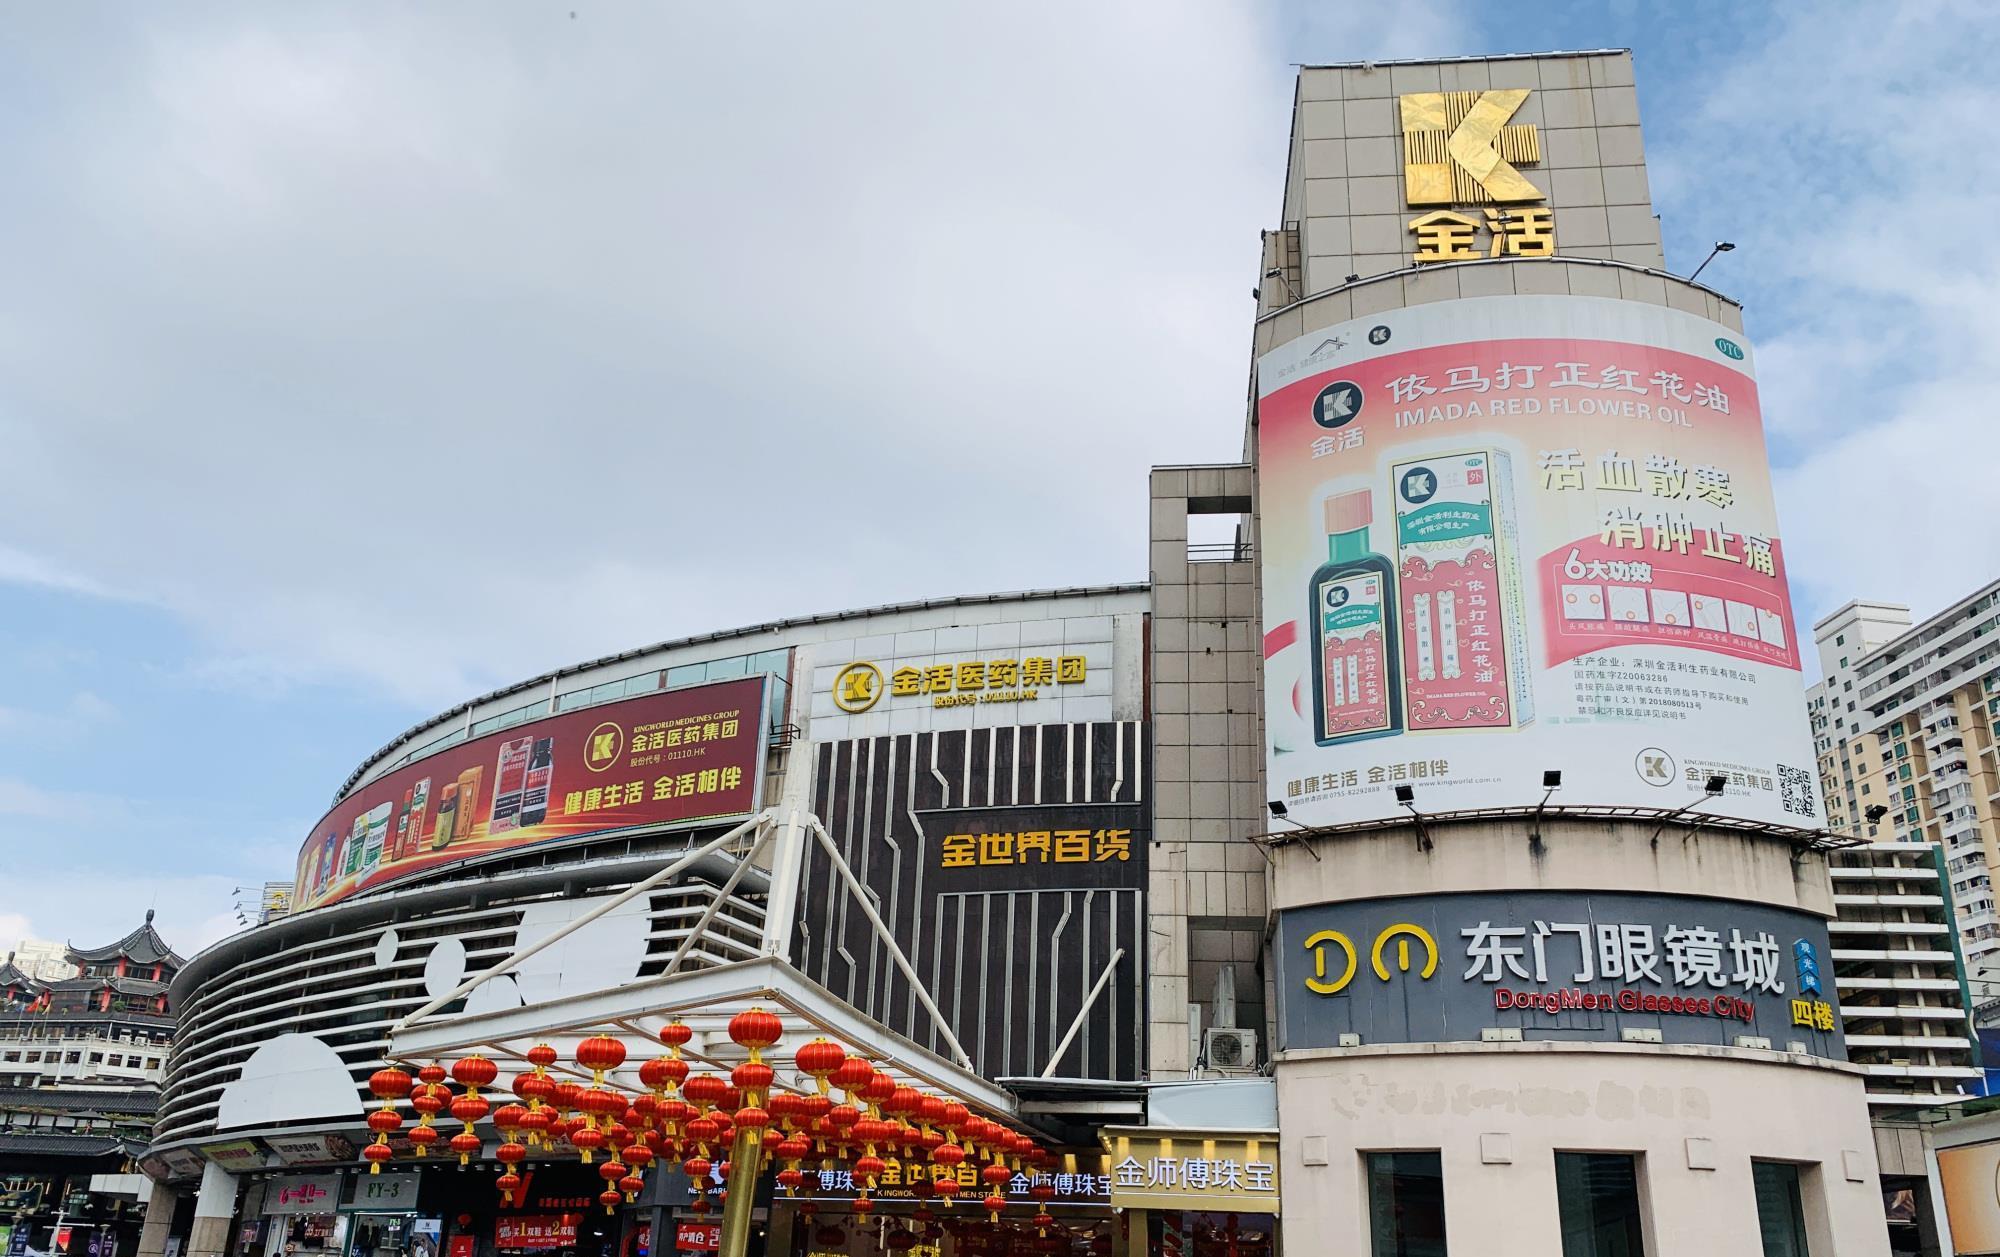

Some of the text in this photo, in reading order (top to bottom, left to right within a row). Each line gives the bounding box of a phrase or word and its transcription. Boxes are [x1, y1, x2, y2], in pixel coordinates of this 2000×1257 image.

[1408, 208, 1554, 262] 金活
[1718, 339, 1742, 359] OTC
[1385, 362, 1731, 416] 依马打正红花油
[1395, 398, 1694, 428] IMADA RED FLOWER OIL
[1311, 427, 1364, 460] 金活
[1537, 448, 1734, 509] 活血散寒
[1600, 505, 1776, 578] 消肿止痛
[1564, 548, 1654, 584] 6大功效
[1466, 580, 1493, 683] 依马打正红花油
[891, 655, 1086, 697] 金活医药集团
[1632, 658, 1756, 684] 深圳金活利生药业有限公司
[631, 719, 739, 753] 金活医药集团
[634, 709, 740, 734] KINGWORLD MEDICINES GROUP
[564, 766, 742, 816] 健康生活 金活相伴
[1287, 760, 1449, 798] 健康生活 金活相伴
[941, 829, 1131, 868] 金世界百货
[1460, 919, 1785, 995] 东门眼镜城
[1495, 987, 1756, 1022] DongMen Glasses City
[1791, 999, 1836, 1032] 四楼
[367, 1182, 400, 1198] FY-3
[1115, 1155, 1276, 1192] 金师傅珠宝
